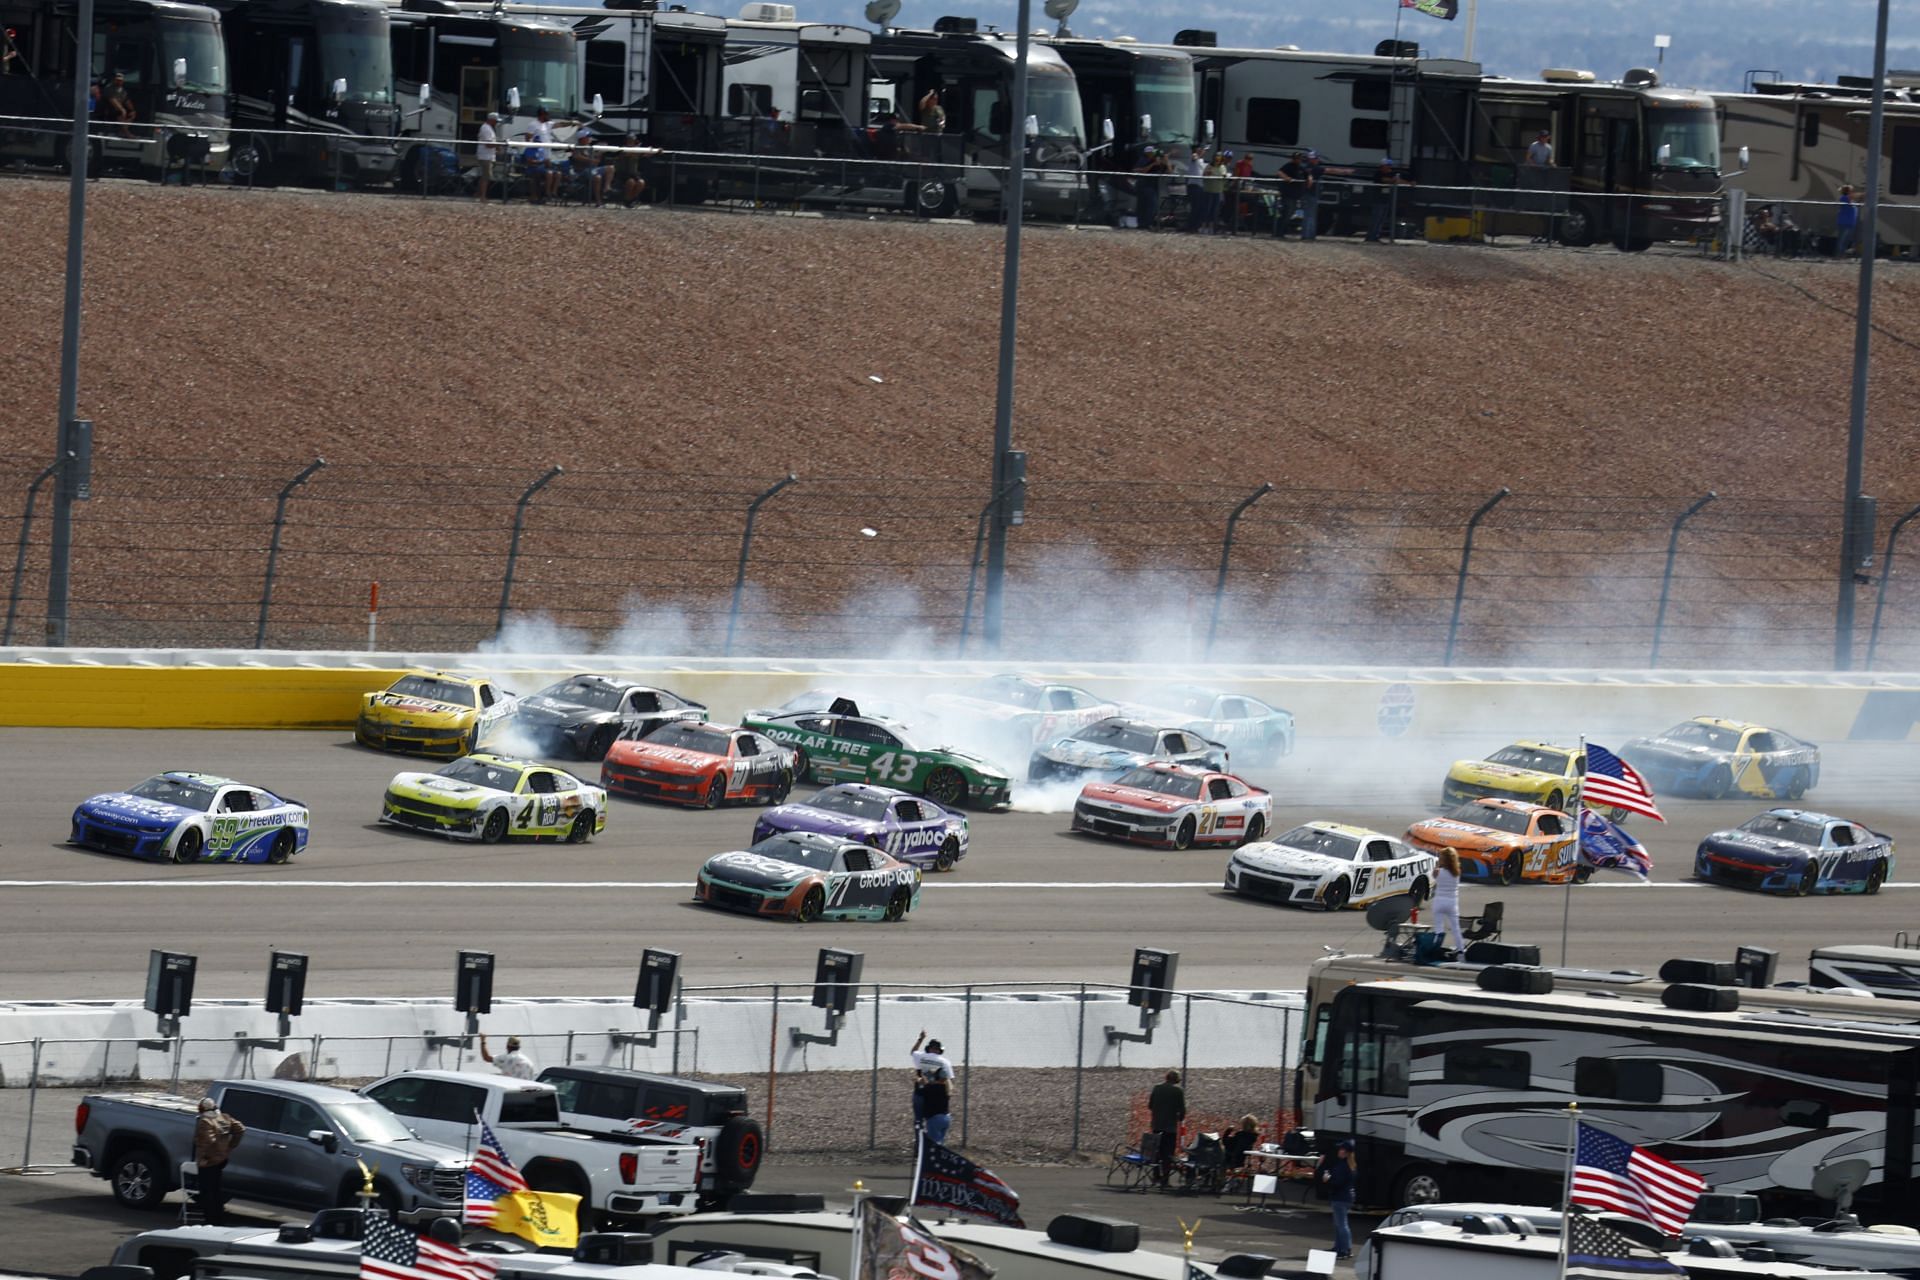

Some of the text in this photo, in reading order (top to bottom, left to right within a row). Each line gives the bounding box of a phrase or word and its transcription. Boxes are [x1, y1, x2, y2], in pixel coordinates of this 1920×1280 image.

[765, 728, 871, 758] DOLLAR TREE
[871, 752, 918, 783] 43
[91, 808, 139, 825] Freeway.com
[248, 811, 304, 829] Freeway.com
[516, 799, 535, 829] 4
[1197, 806, 1218, 835] 21
[208, 816, 241, 850] 99
[885, 831, 904, 856] 11
[1388, 858, 1435, 882] ACTION
[1525, 843, 1550, 872] 35
[1818, 850, 1844, 880] 77
[826, 877, 853, 907] 71
[859, 872, 894, 889] GROUP
[1351, 866, 1372, 897] 16
[896, 1224, 960, 1280] 3
